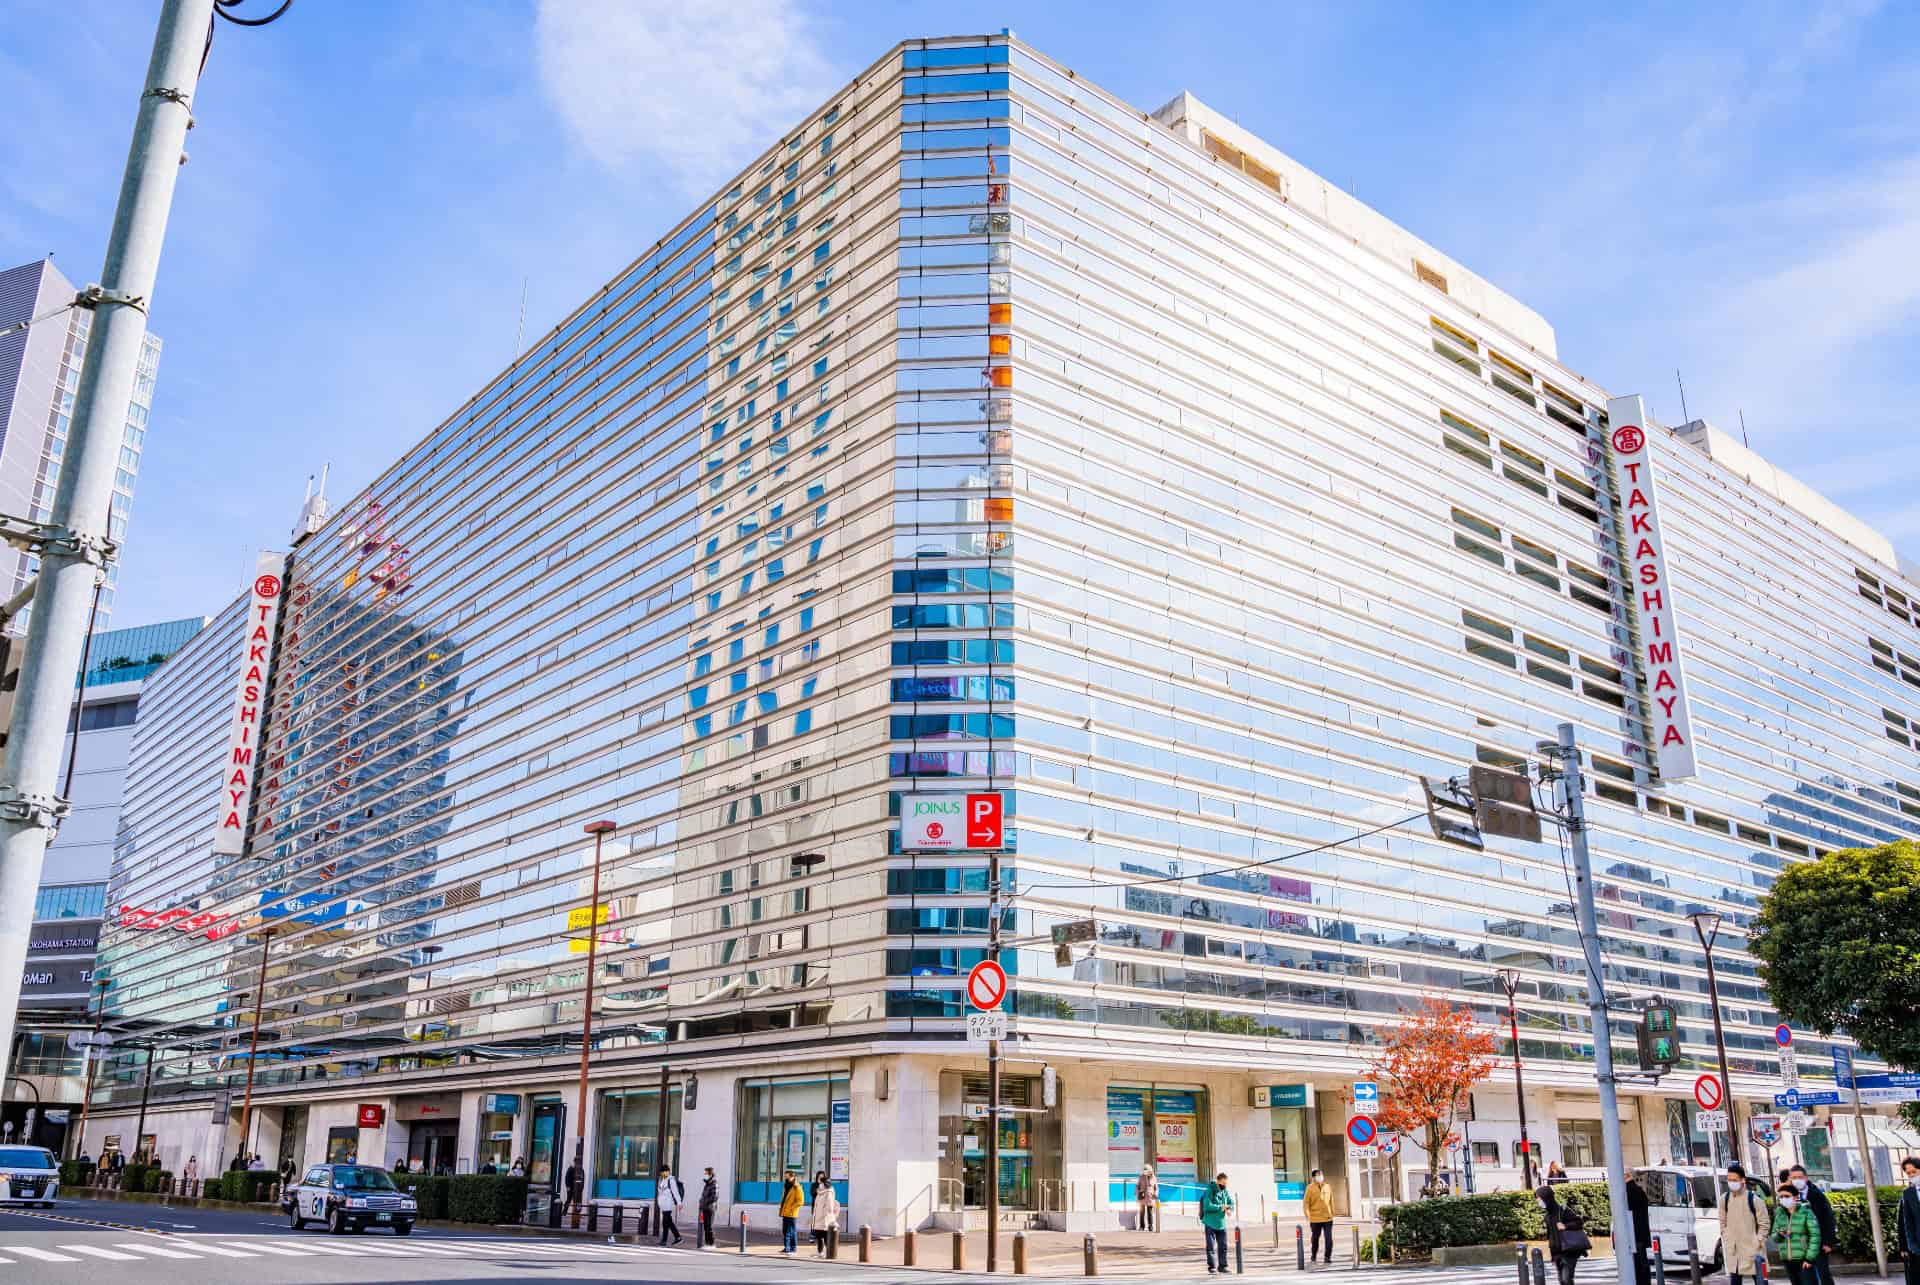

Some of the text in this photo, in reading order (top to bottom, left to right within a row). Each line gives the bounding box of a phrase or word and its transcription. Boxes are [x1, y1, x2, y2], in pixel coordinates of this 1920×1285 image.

[1624, 462, 1684, 747] TAKASHIMAYA
[224, 605, 273, 830] TAKASHIMAYA
[913, 800, 961, 816] JOINUS
[974, 800, 993, 823] P
[65, 938, 95, 948] STATION
